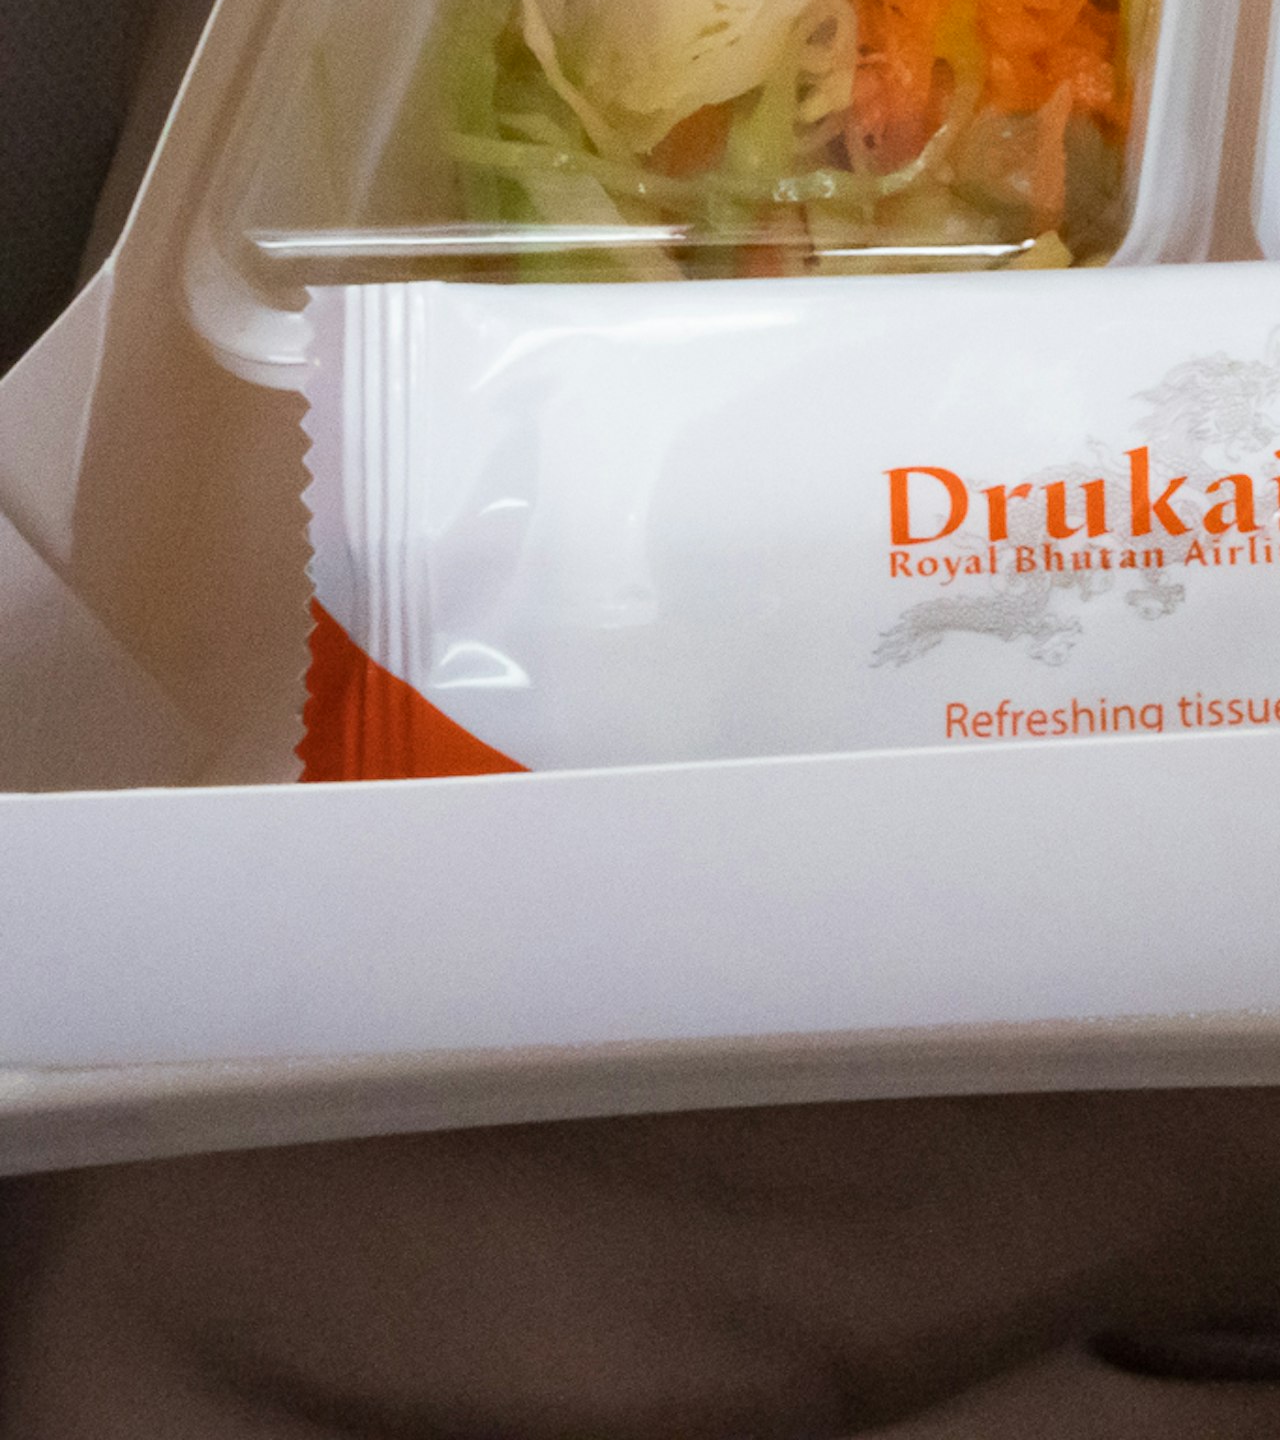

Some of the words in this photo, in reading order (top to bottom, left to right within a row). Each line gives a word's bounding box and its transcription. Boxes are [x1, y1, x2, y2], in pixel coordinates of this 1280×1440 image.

[889, 548, 999, 585] Royal
[1014, 539, 1165, 574] Bhutan
[944, 697, 1165, 740] Refreshing
